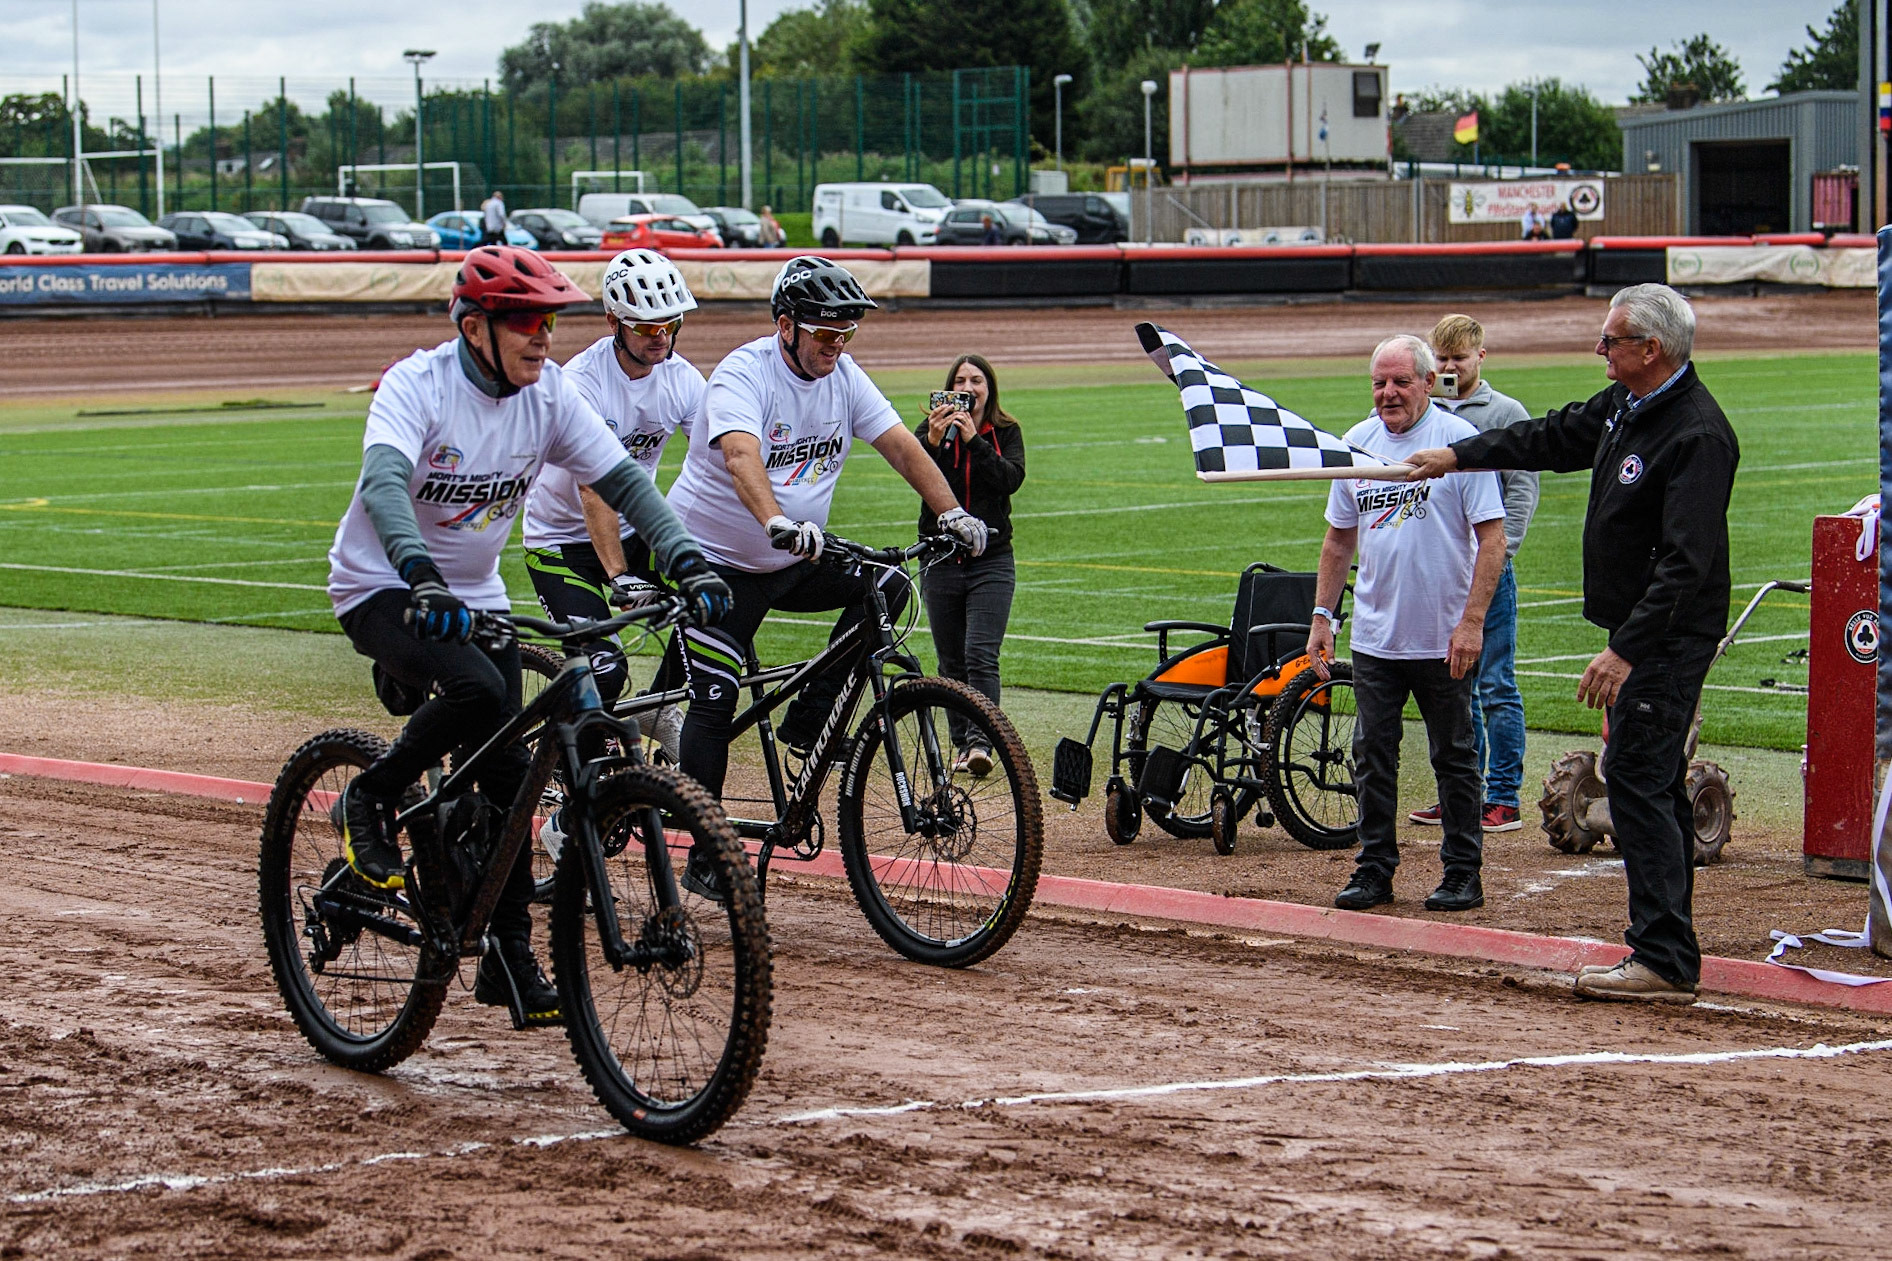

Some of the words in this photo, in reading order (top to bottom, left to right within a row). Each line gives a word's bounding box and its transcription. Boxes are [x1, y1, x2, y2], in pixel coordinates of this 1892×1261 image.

[1498, 184, 1555, 199] MANCHESTER
[0, 274, 34, 293] orld
[38, 274, 86, 292] Class
[89, 273, 143, 291] Travel
[147, 272, 228, 291] Solutions
[765, 437, 843, 469] MISSION
[416, 475, 532, 504] MISSION
[427, 471, 467, 483] MORT'S
[1381, 484, 1407, 493] MIGHTY
[1357, 486, 1431, 513] MISSION
[1849, 614, 1861, 631] BELLE
[1862, 613, 1874, 621] VUE
[850, 739, 866, 774] ROLLER
[845, 772, 856, 797] HIGH
[895, 771, 912, 808] ROCKSHOX
